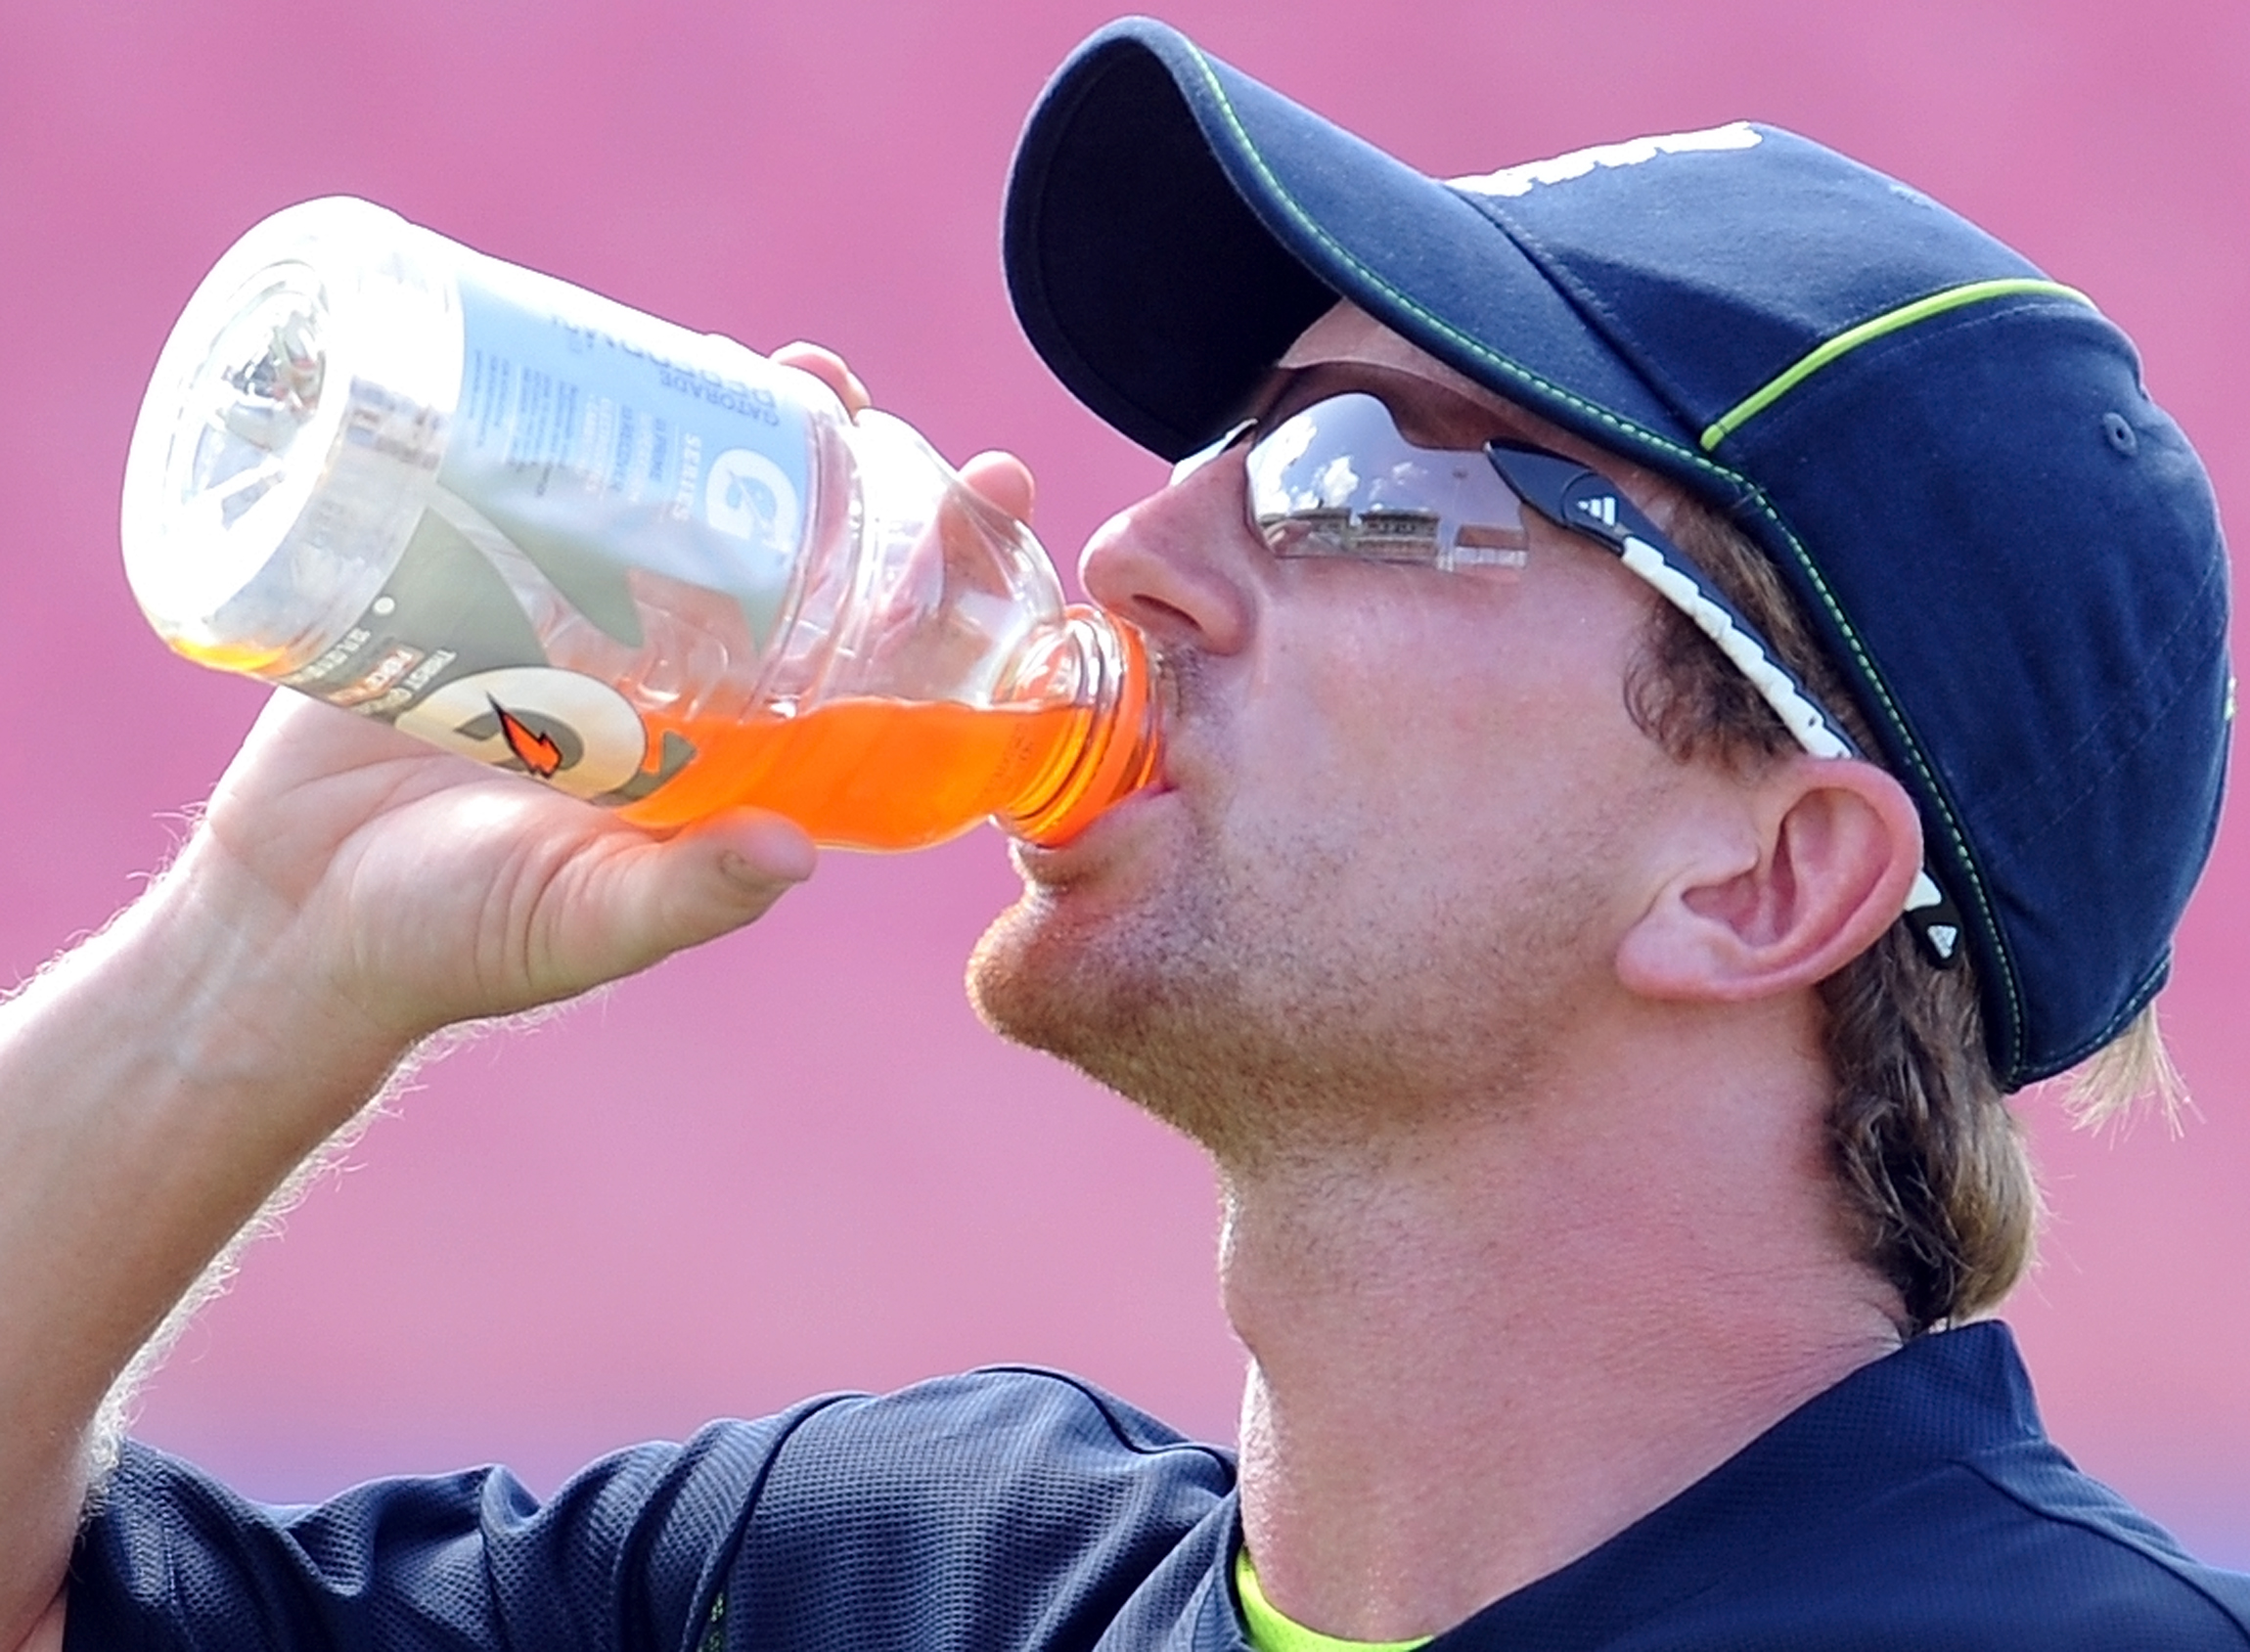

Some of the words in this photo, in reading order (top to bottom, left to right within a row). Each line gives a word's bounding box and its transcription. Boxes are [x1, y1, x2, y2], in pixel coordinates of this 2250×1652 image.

[659, 367, 780, 426] GATORADE
[672, 431, 701, 521] SERIES
[705, 448, 797, 555] G
